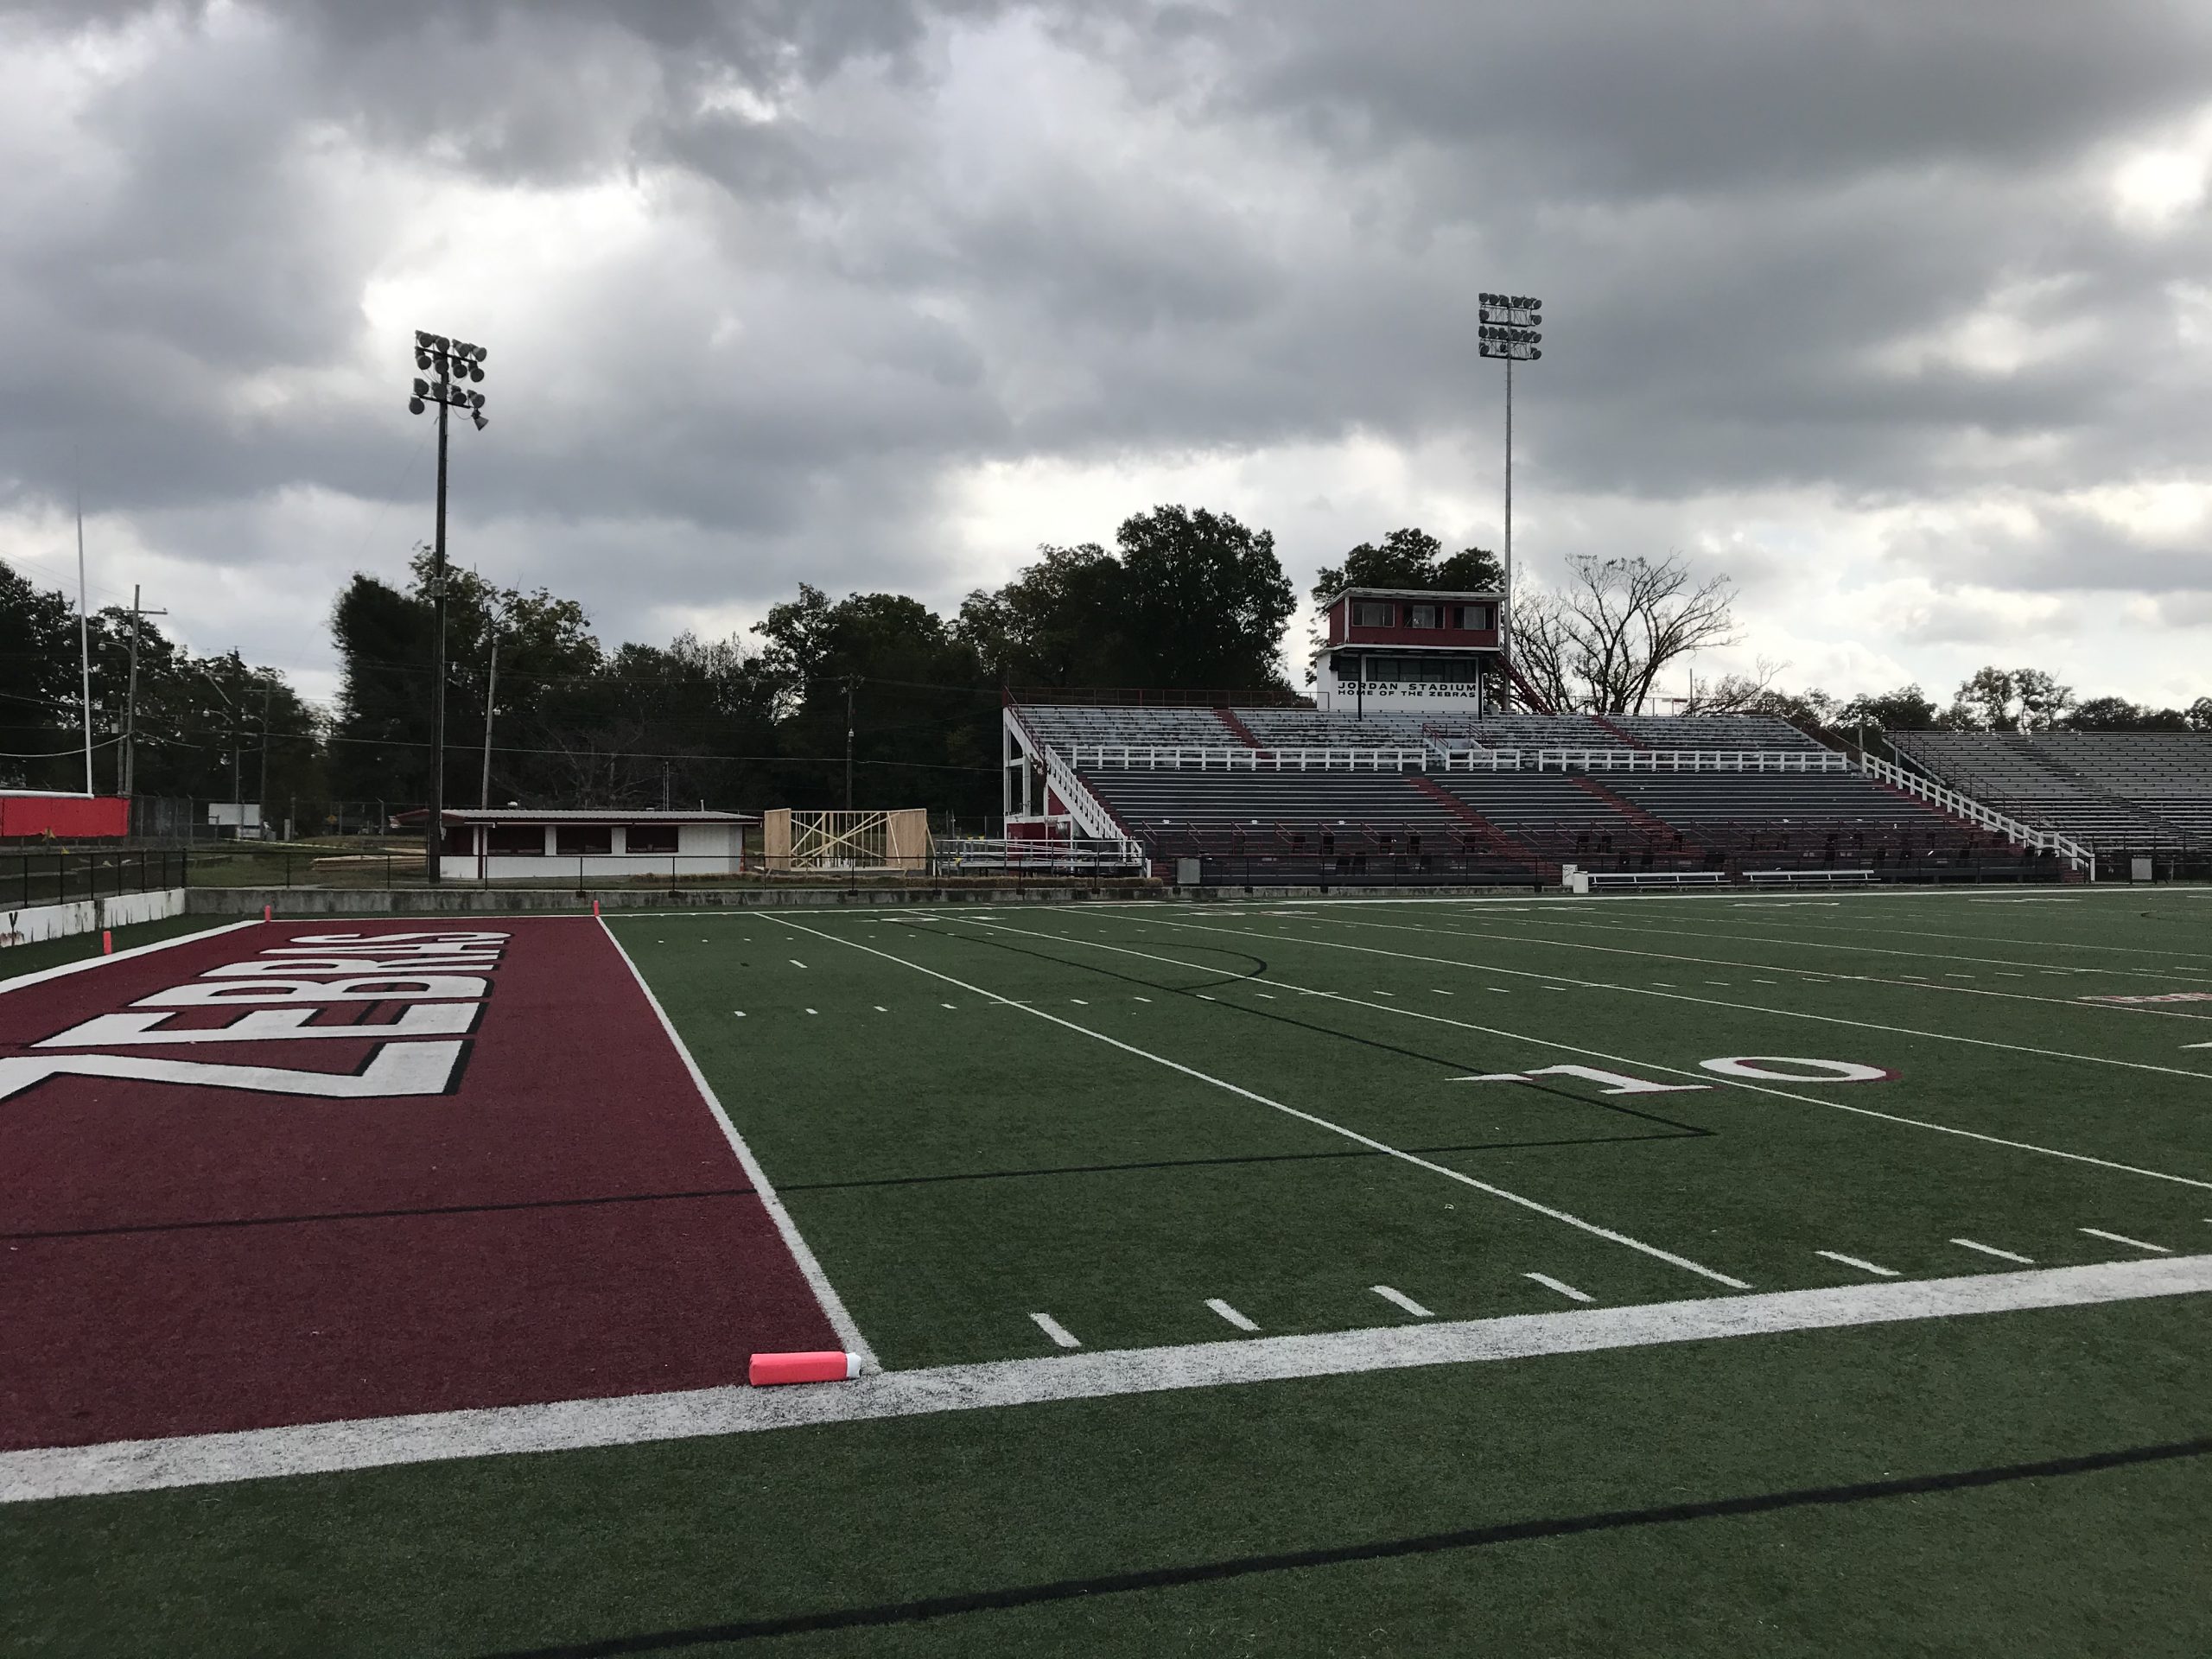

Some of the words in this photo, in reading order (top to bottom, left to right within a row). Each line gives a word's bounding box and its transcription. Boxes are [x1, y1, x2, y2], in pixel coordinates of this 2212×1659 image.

[1338, 682, 1398, 690] JORDAN
[1408, 683, 1477, 691] STADIUM
[0, 931, 512, 1098] ZEBRAS
